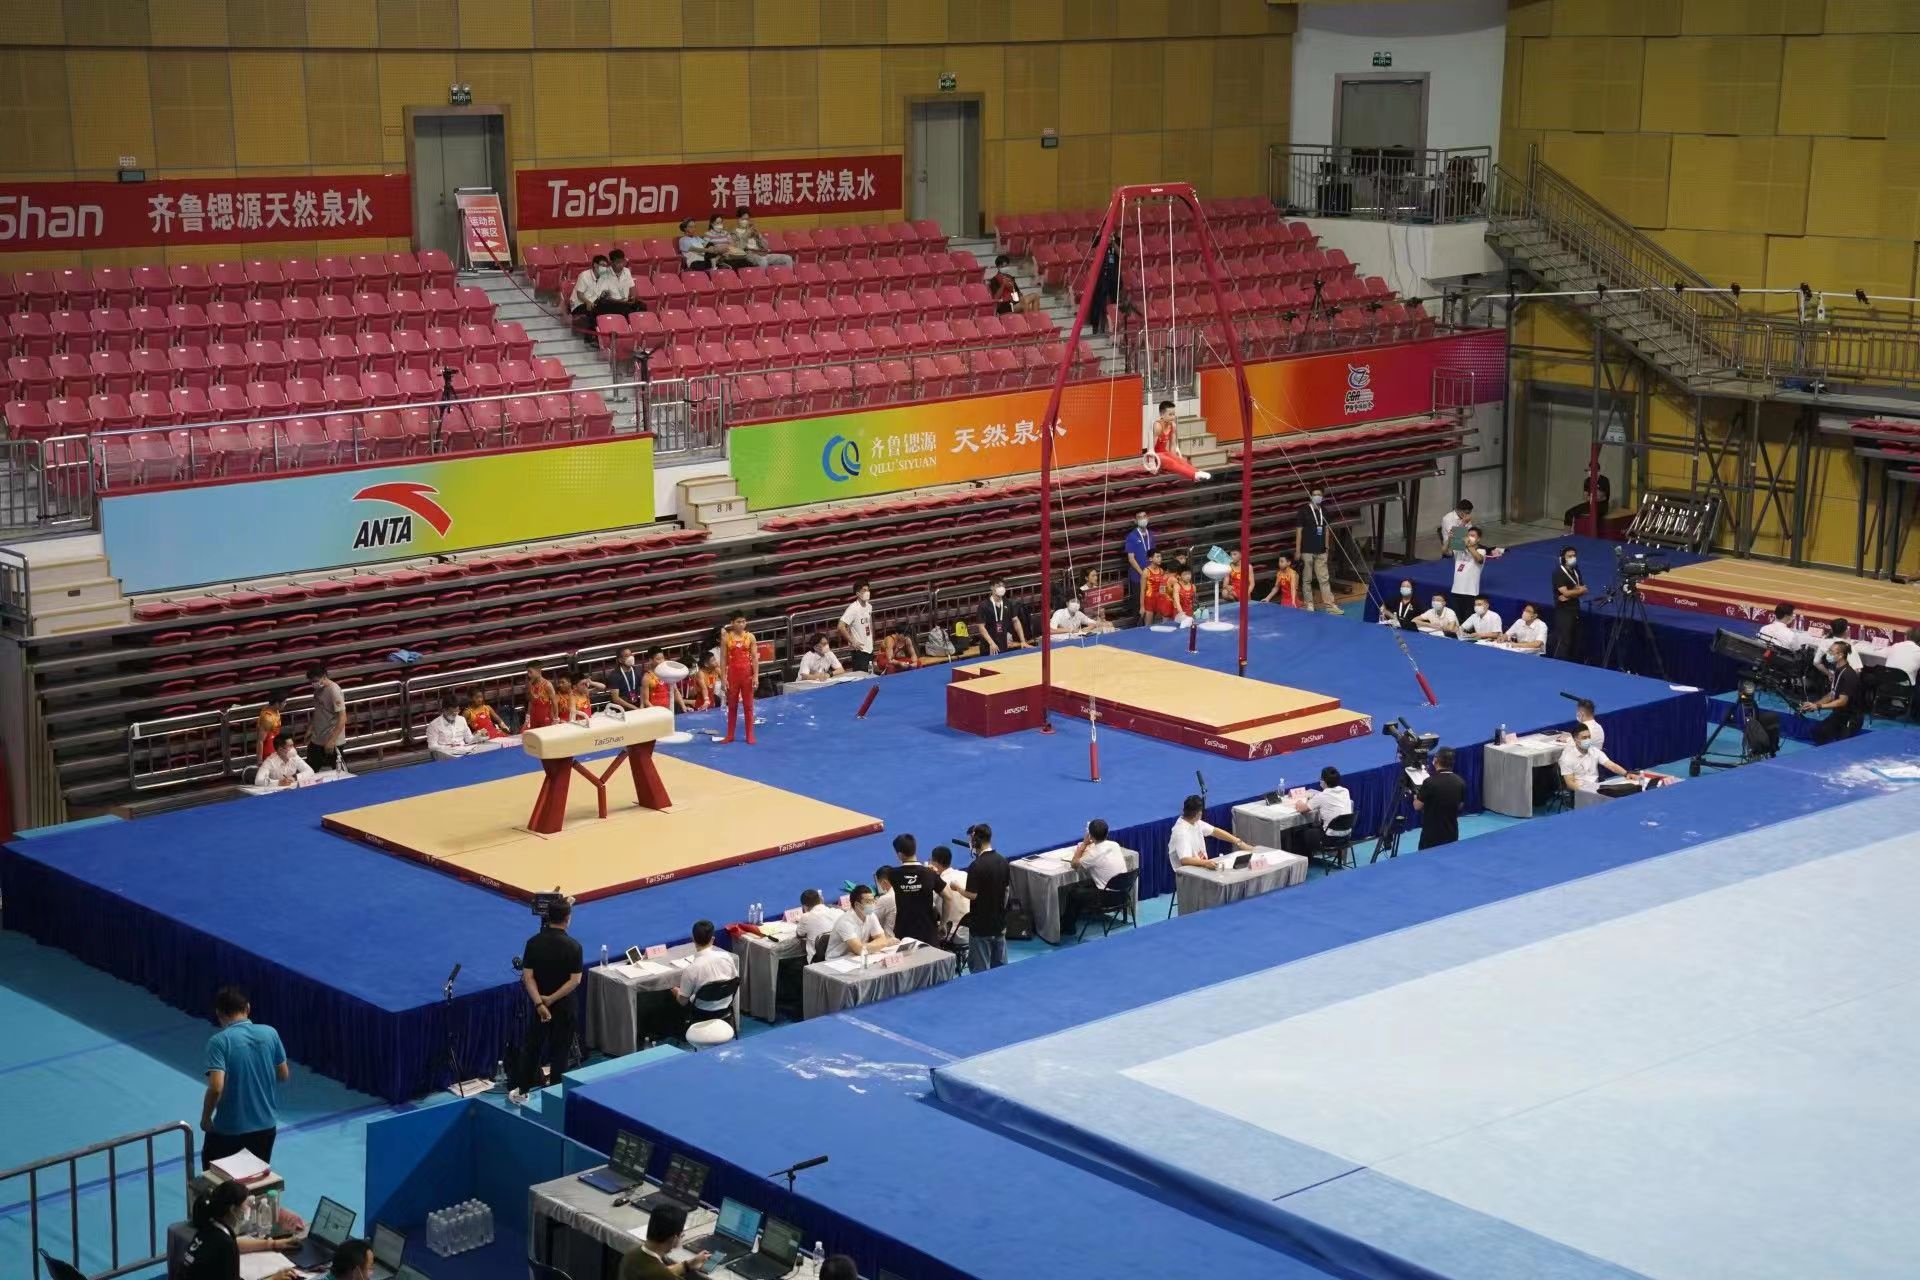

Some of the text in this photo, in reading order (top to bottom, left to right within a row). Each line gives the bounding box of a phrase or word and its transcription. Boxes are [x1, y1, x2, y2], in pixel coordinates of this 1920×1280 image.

[710, 168, 876, 210] 齐鲁锶源天然泉水
[547, 177, 679, 218] TaiShan
[147, 188, 374, 234] 齐鲁锶源天然泉水
[353, 515, 412, 550] ANTA
[1808, 620, 1832, 630] TaiSha
[593, 735, 624, 747] TaiShan
[1203, 738, 1228, 750] TaiShan
[1300, 733, 1324, 744] TaiShan
[778, 841, 806, 852] TaiShan
[645, 872, 675, 884] TaiShan
